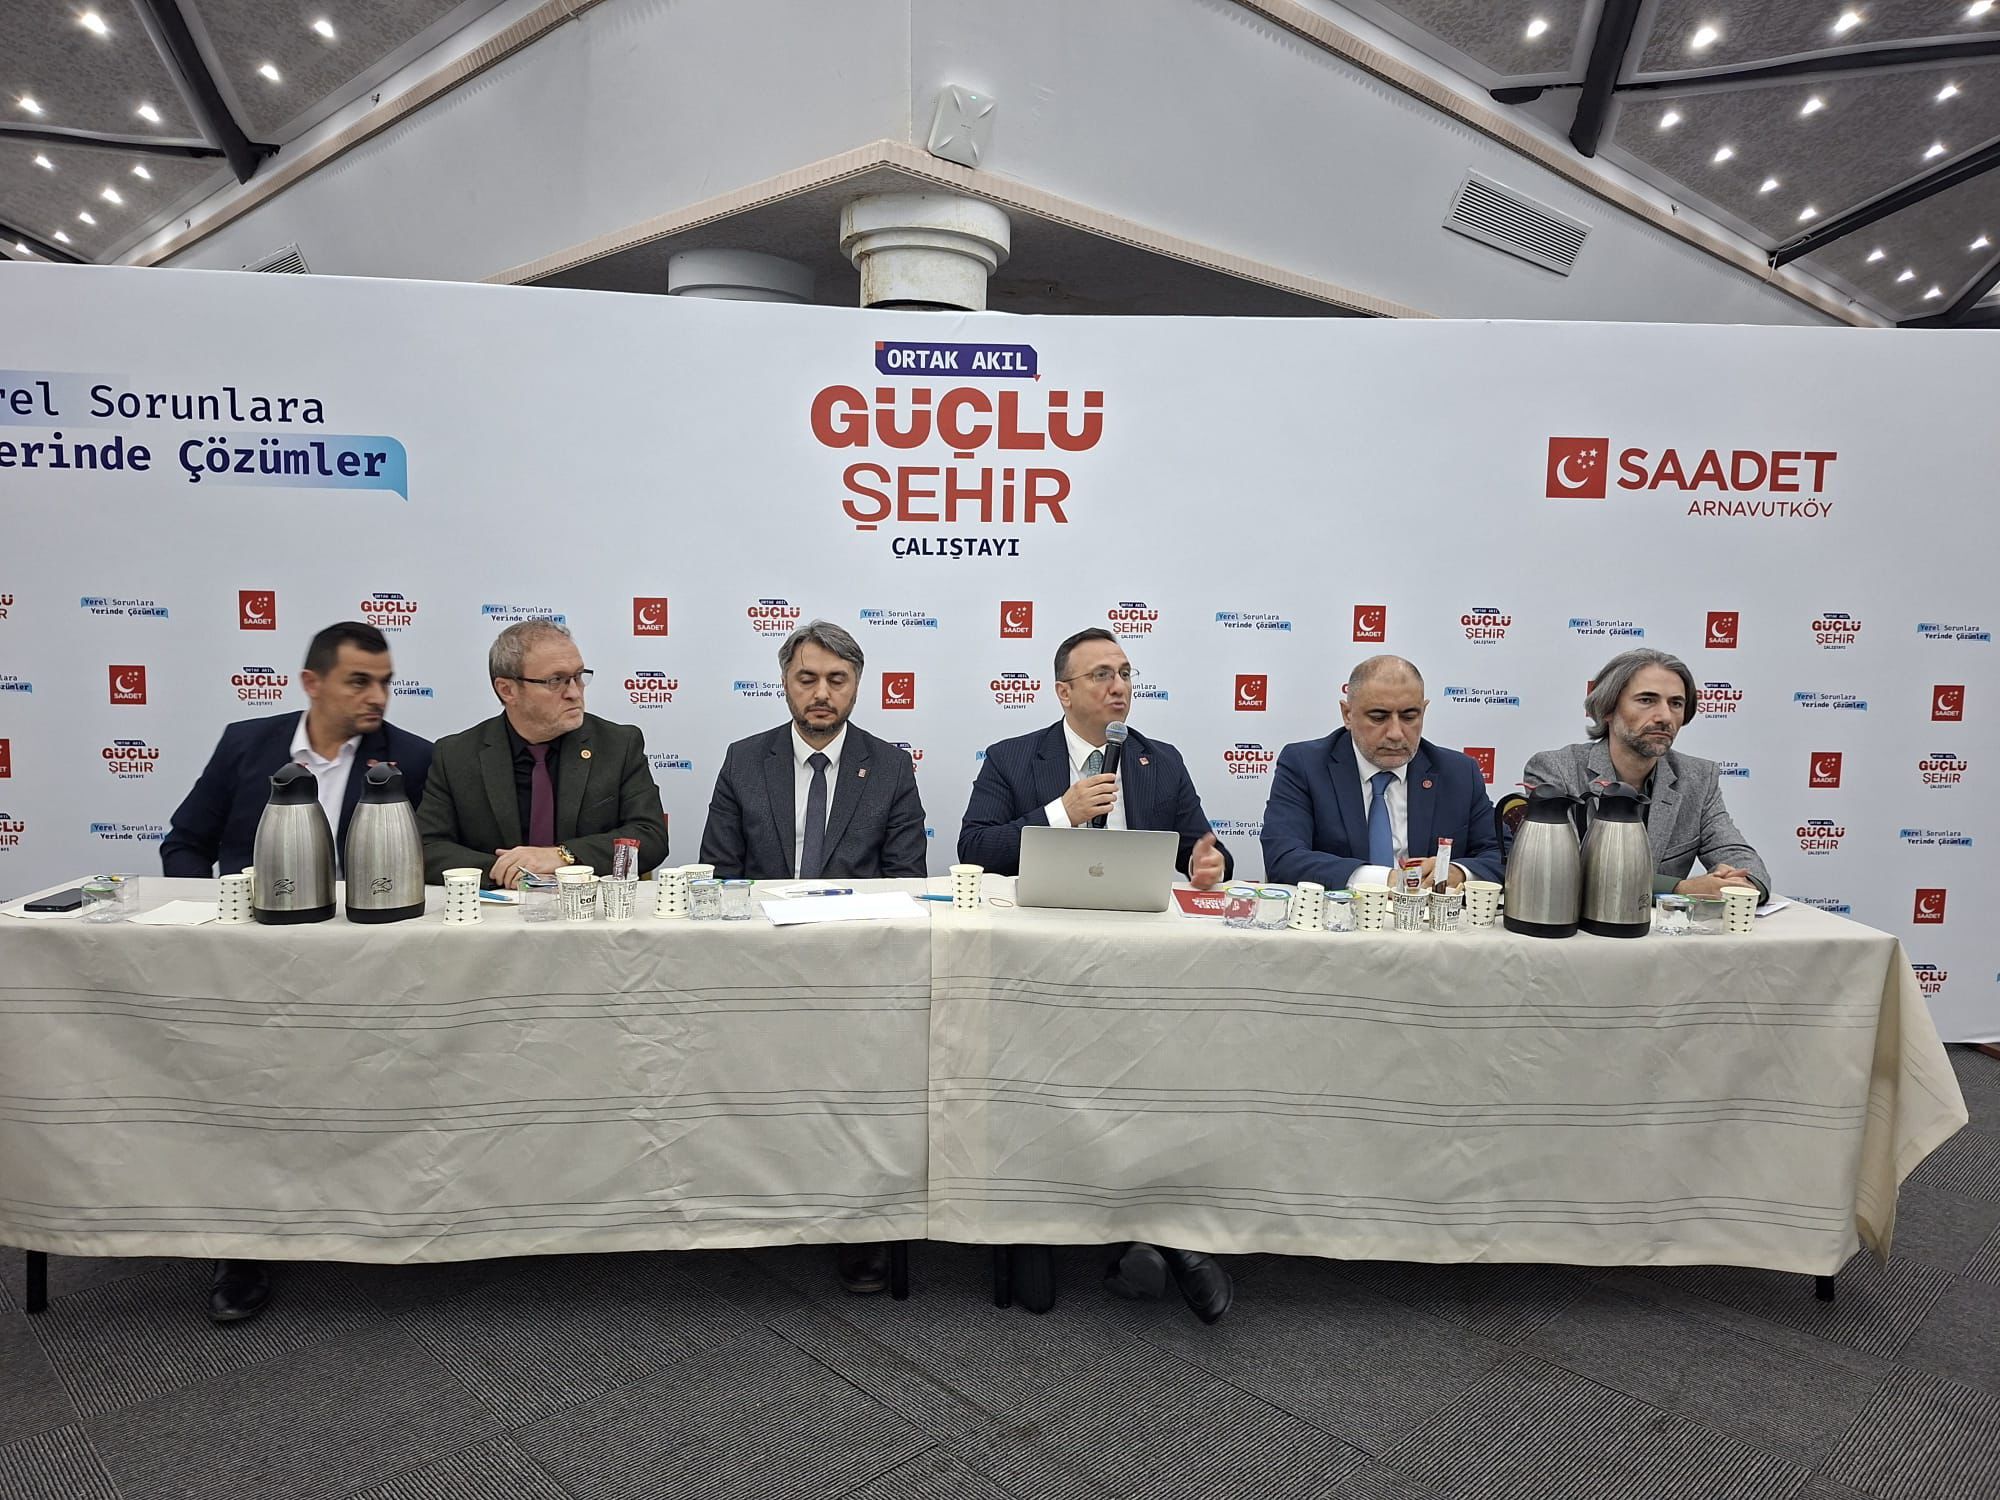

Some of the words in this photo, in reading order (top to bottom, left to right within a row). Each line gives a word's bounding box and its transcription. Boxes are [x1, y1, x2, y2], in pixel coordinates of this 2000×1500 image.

[887, 349, 959, 370] ORTAK
[971, 351, 1028, 371] AKIL
[90, 384, 325, 424] Sorunlara
[810, 384, 1104, 459] GÜÇLÜ
[0, 432, 152, 471] erinde
[179, 436, 388, 483] Çözümler
[1617, 447, 1838, 493] SAADET
[1687, 498, 1833, 518] ARNAVUTKÖY
[891, 537, 1020, 559] ÇALIŞTAYI
[361, 601, 417, 614] GÜÇLÜ
[748, 607, 800, 619] GÜÇLÜ
[1108, 610, 1158, 622] GÜÇLÜ
[1461, 615, 1511, 627] GÜÇLÜ
[1812, 621, 1861, 633] GÜÇLÜ
[0, 683, 30, 691] zümler
[231, 675, 288, 688] GÜÇLÜ
[624, 679, 678, 691] GÜÇLÜ
[990, 680, 1040, 692] GÜÇLÜ
[102, 748, 159, 761] GÜÇLÜ
[1224, 751, 1273, 762] GÜÇLÜ
[1919, 761, 1967, 772] GÜÇLÜ
[1797, 827, 1845, 838] GÜÇLÜ
[1916, 971, 1947, 983] ÇLÜ
